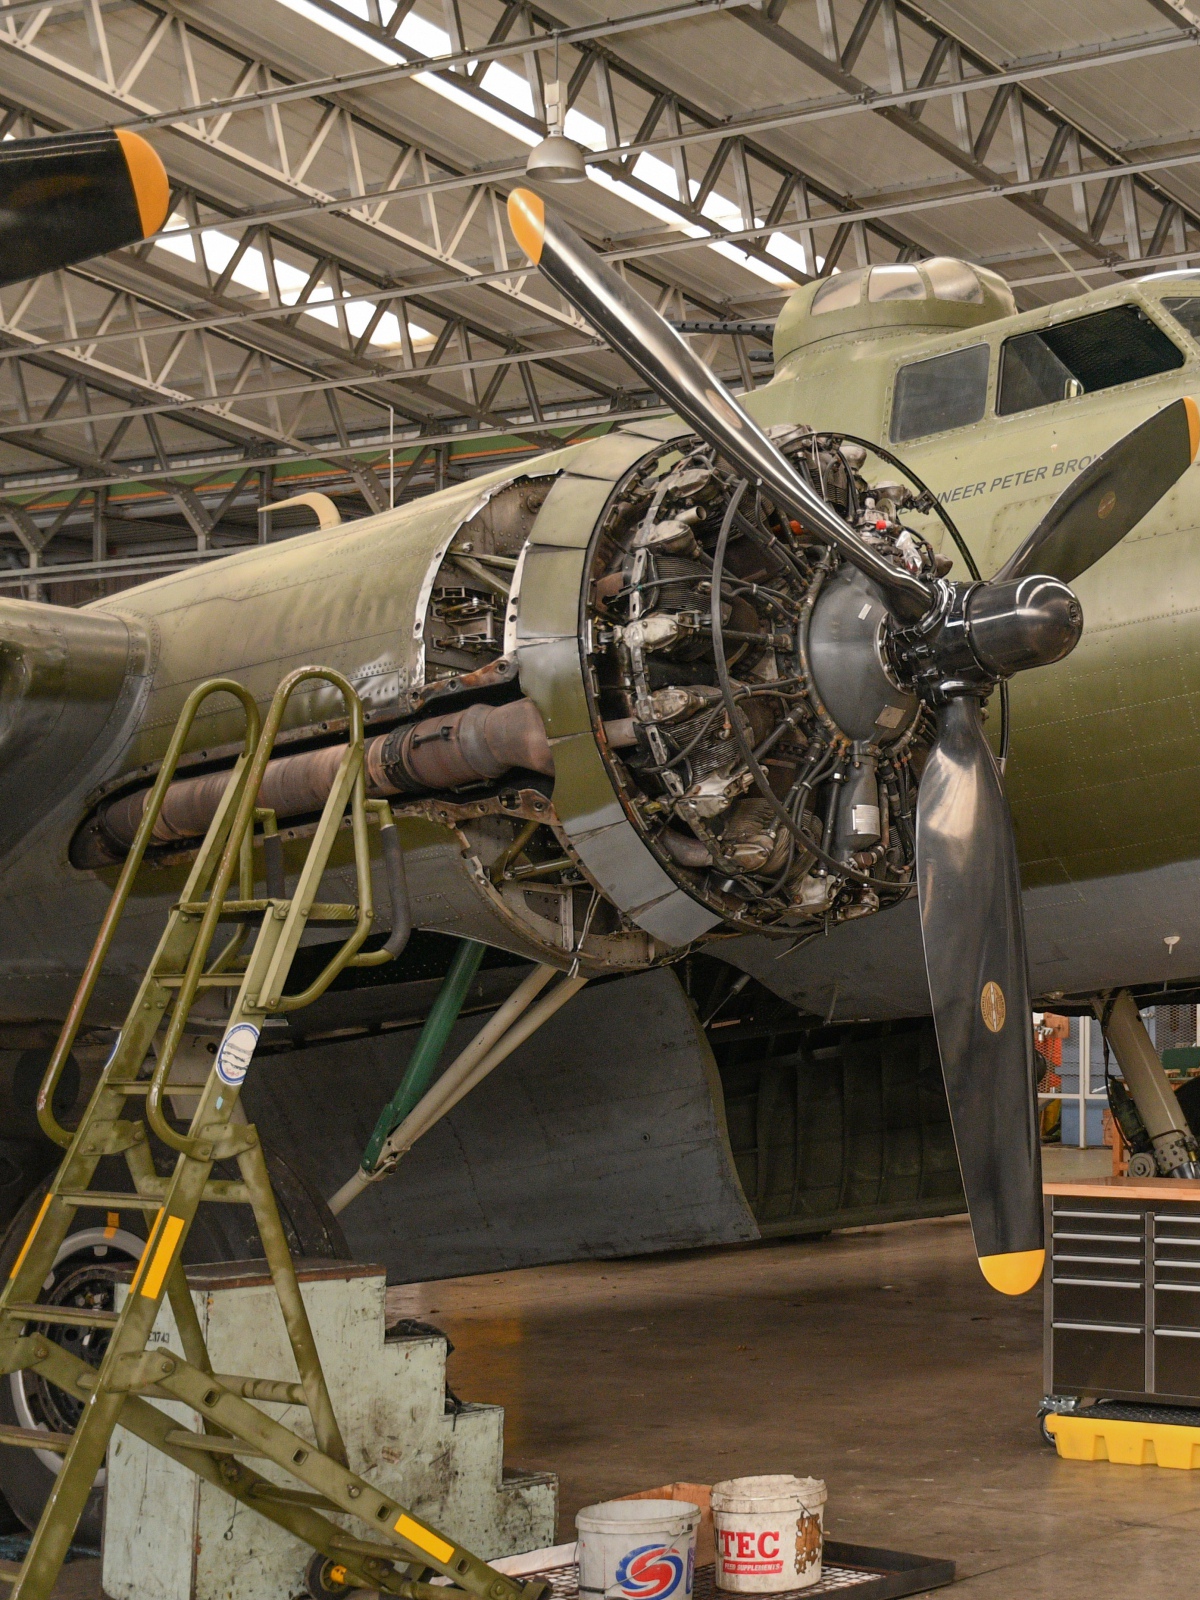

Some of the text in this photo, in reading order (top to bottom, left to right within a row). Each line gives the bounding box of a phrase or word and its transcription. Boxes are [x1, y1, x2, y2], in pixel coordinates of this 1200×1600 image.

[990, 465, 1048, 493] PETER
[1051, 454, 1098, 477] BRO
[719, 1529, 781, 1559] TEC
